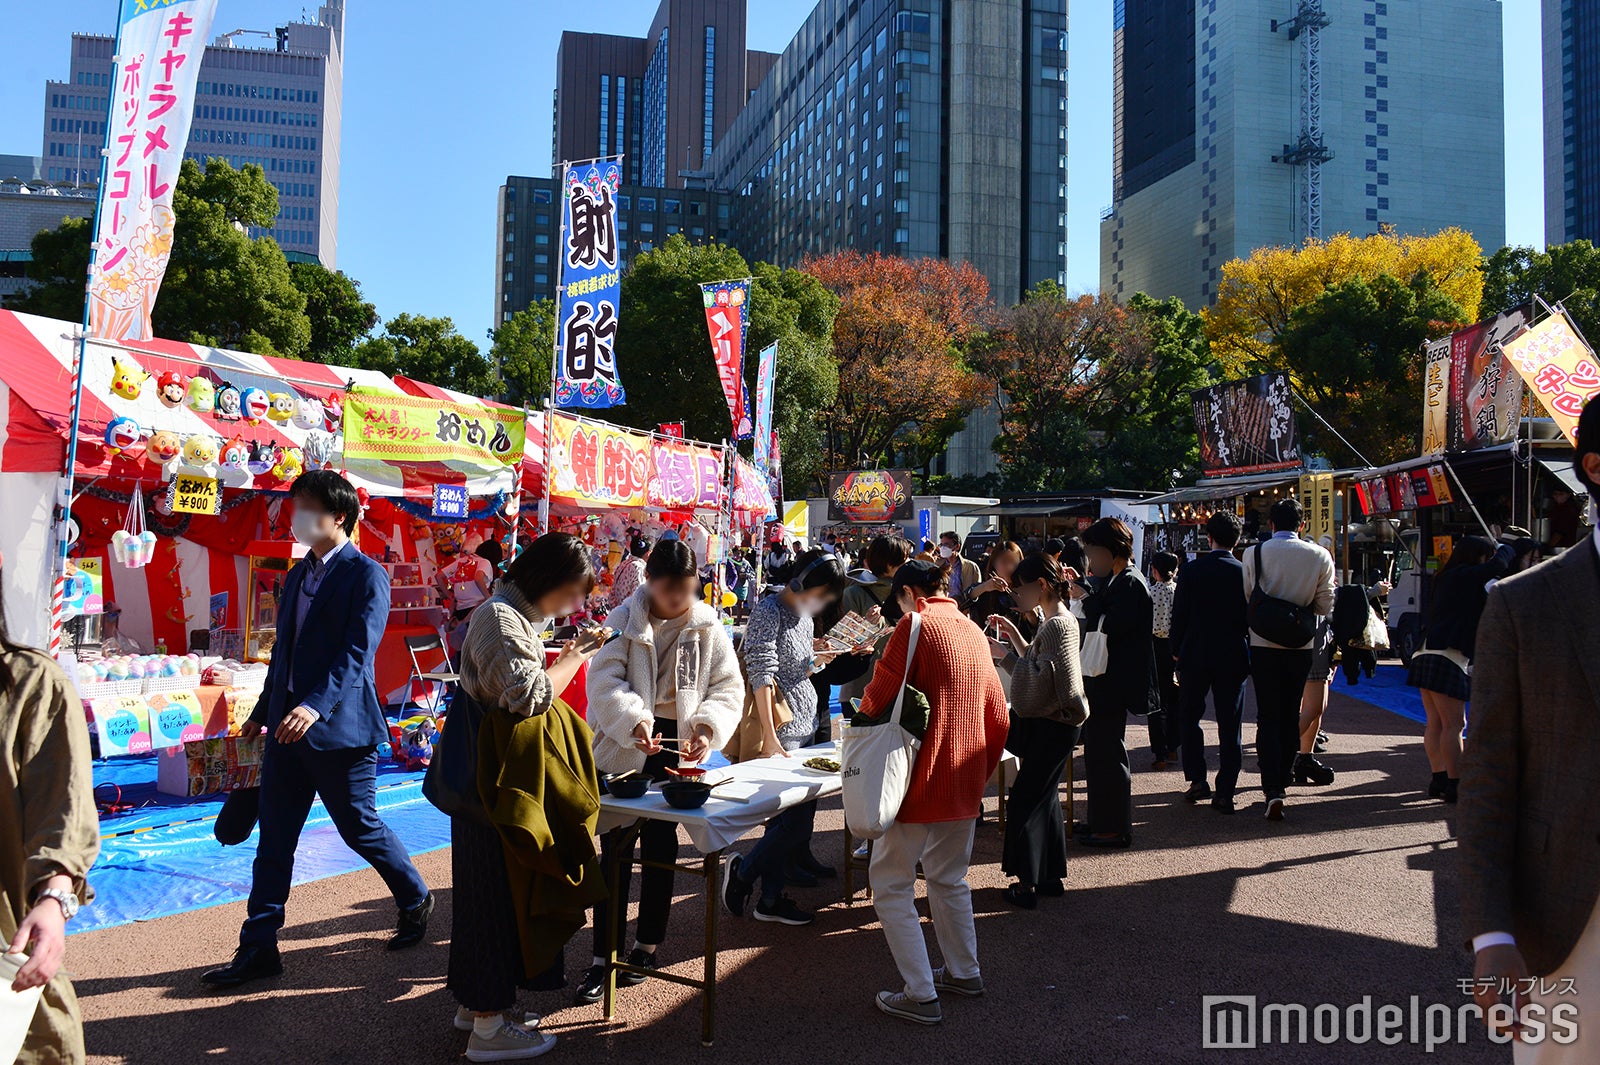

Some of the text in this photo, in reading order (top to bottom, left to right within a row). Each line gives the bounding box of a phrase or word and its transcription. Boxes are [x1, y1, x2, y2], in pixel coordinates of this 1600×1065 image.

[144, 11, 194, 201] キャラメル
[103, 52, 146, 272] ポップコーン
[567, 184, 618, 385] 射的
[1426, 345, 1450, 363] BEER
[1425, 362, 1444, 454] 生ビール
[363, 424, 431, 441] キャラクター
[435, 410, 512, 453] おめん
[570, 429, 648, 498] 射的
[656, 450, 721, 504] 縁日
[178, 495, 208, 510] ¥900
[179, 479, 214, 496] おめん
[439, 487, 463, 503] おめん
[1320, 488, 1329, 533] 一番搾り
